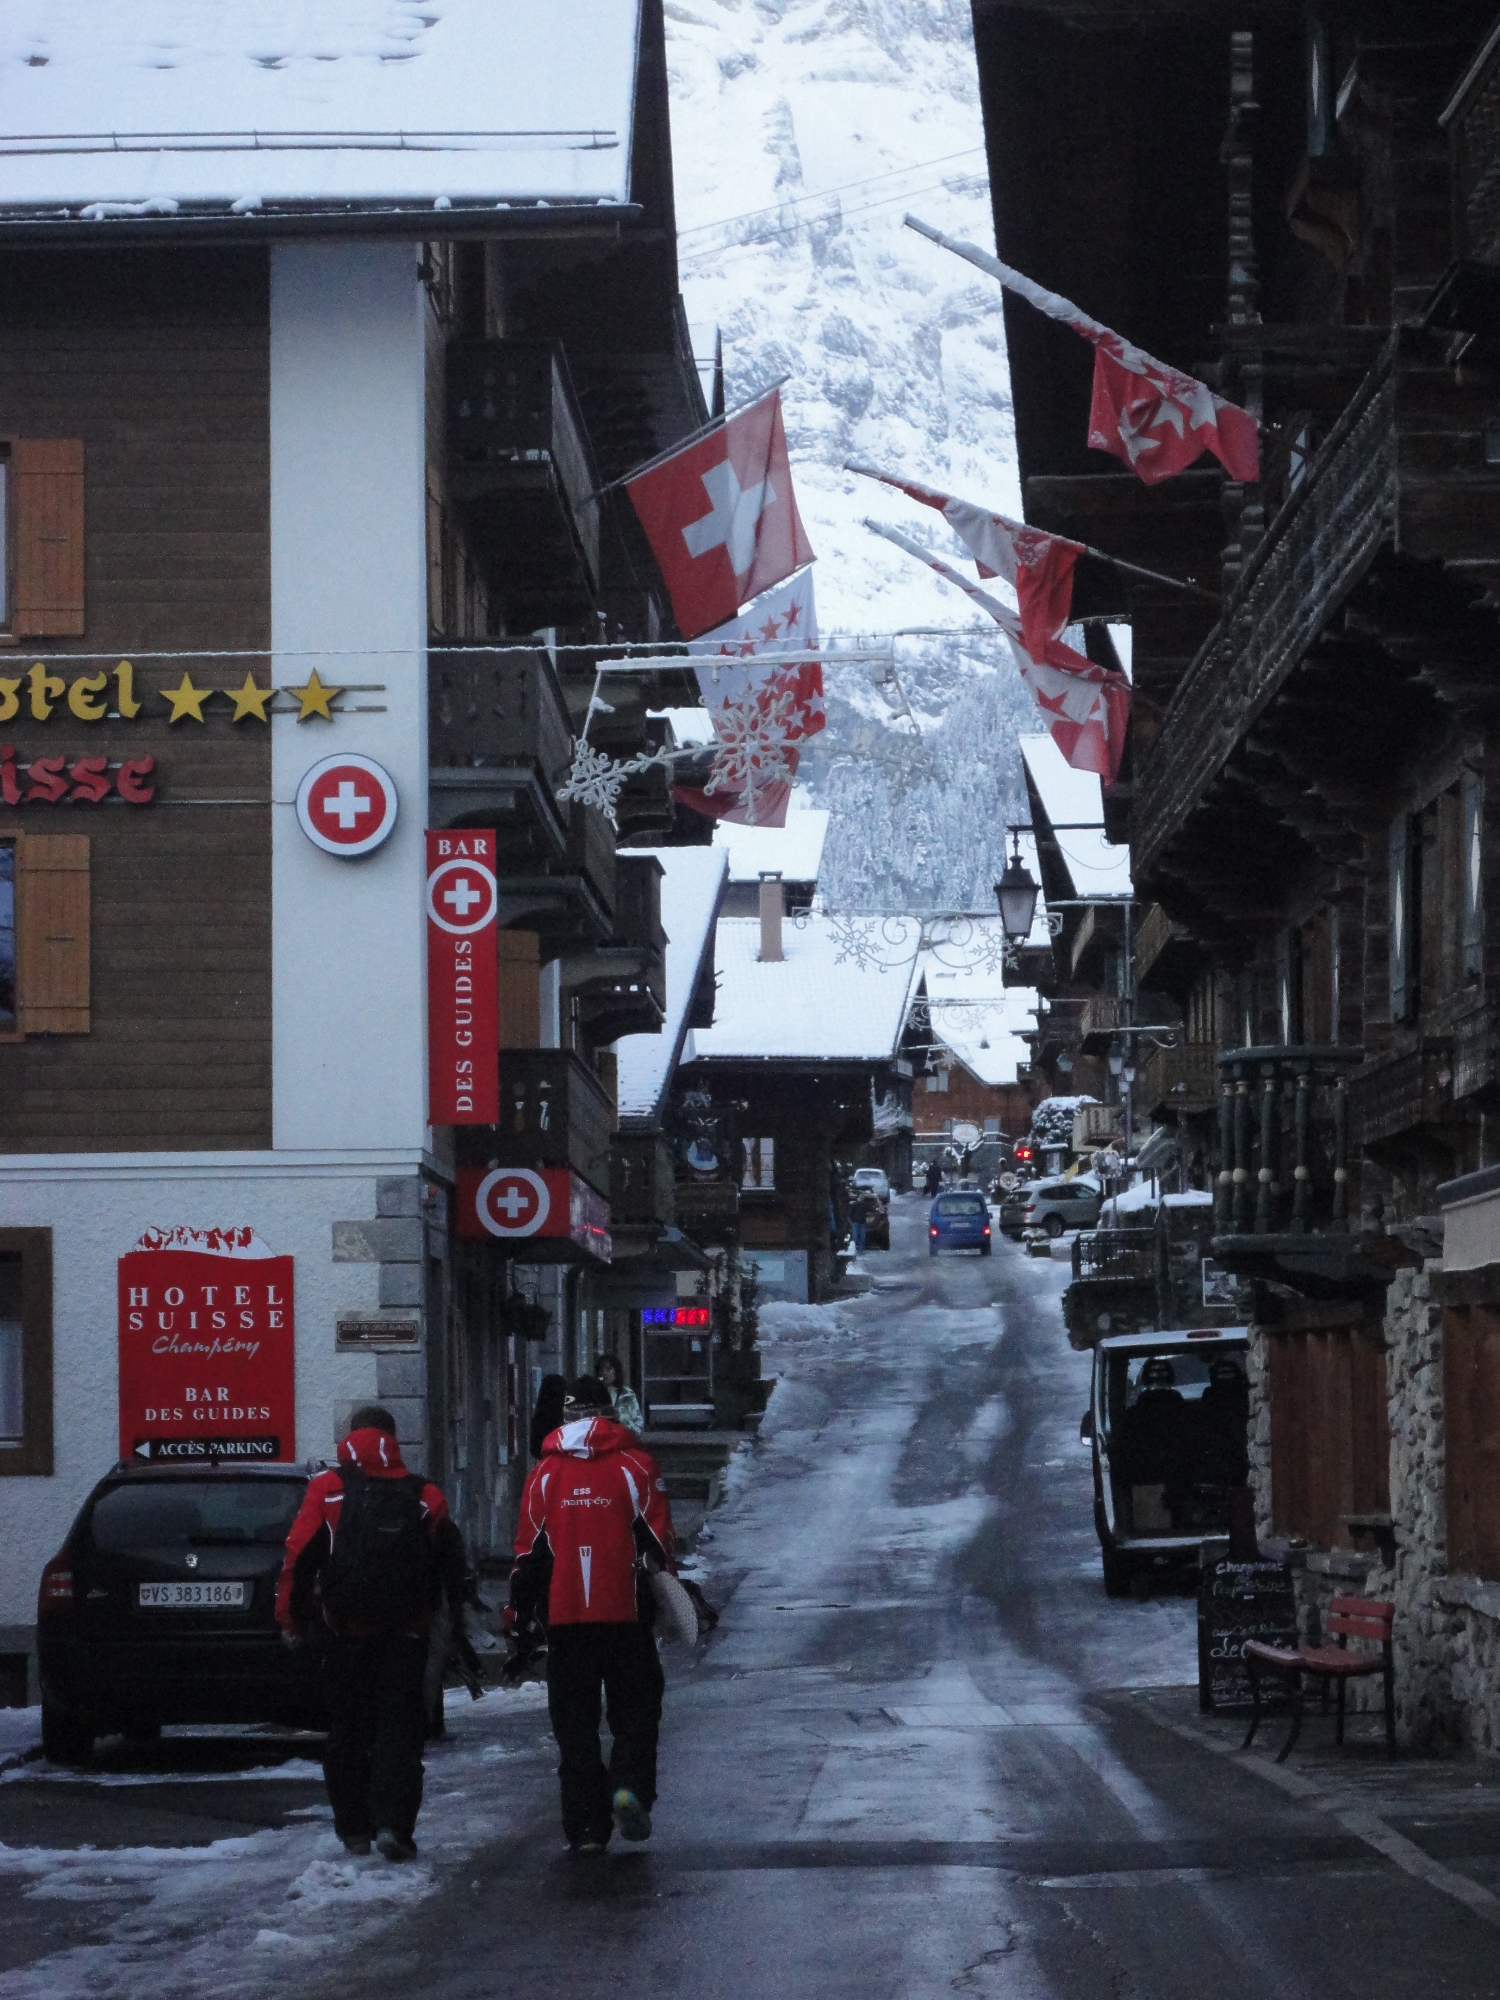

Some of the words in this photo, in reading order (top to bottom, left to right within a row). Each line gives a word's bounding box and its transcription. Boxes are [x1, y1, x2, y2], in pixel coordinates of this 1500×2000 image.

[438, 839, 487, 855] BAR
[455, 940, 473, 1047] GUIDES
[456, 1060, 473, 1112] DES
[128, 1285, 284, 1307] HOTEL
[129, 1311, 284, 1331] SUISSE
[152, 1333, 260, 1361] Champéry
[185, 1387, 229, 1402] BAR
[145, 1408, 183, 1421] DES
[192, 1407, 270, 1420] GUIDES
[158, 1441, 205, 1456] ACCÈS
[209, 1442, 273, 1455] PARKING
[573, 1487, 591, 1496] ESS
